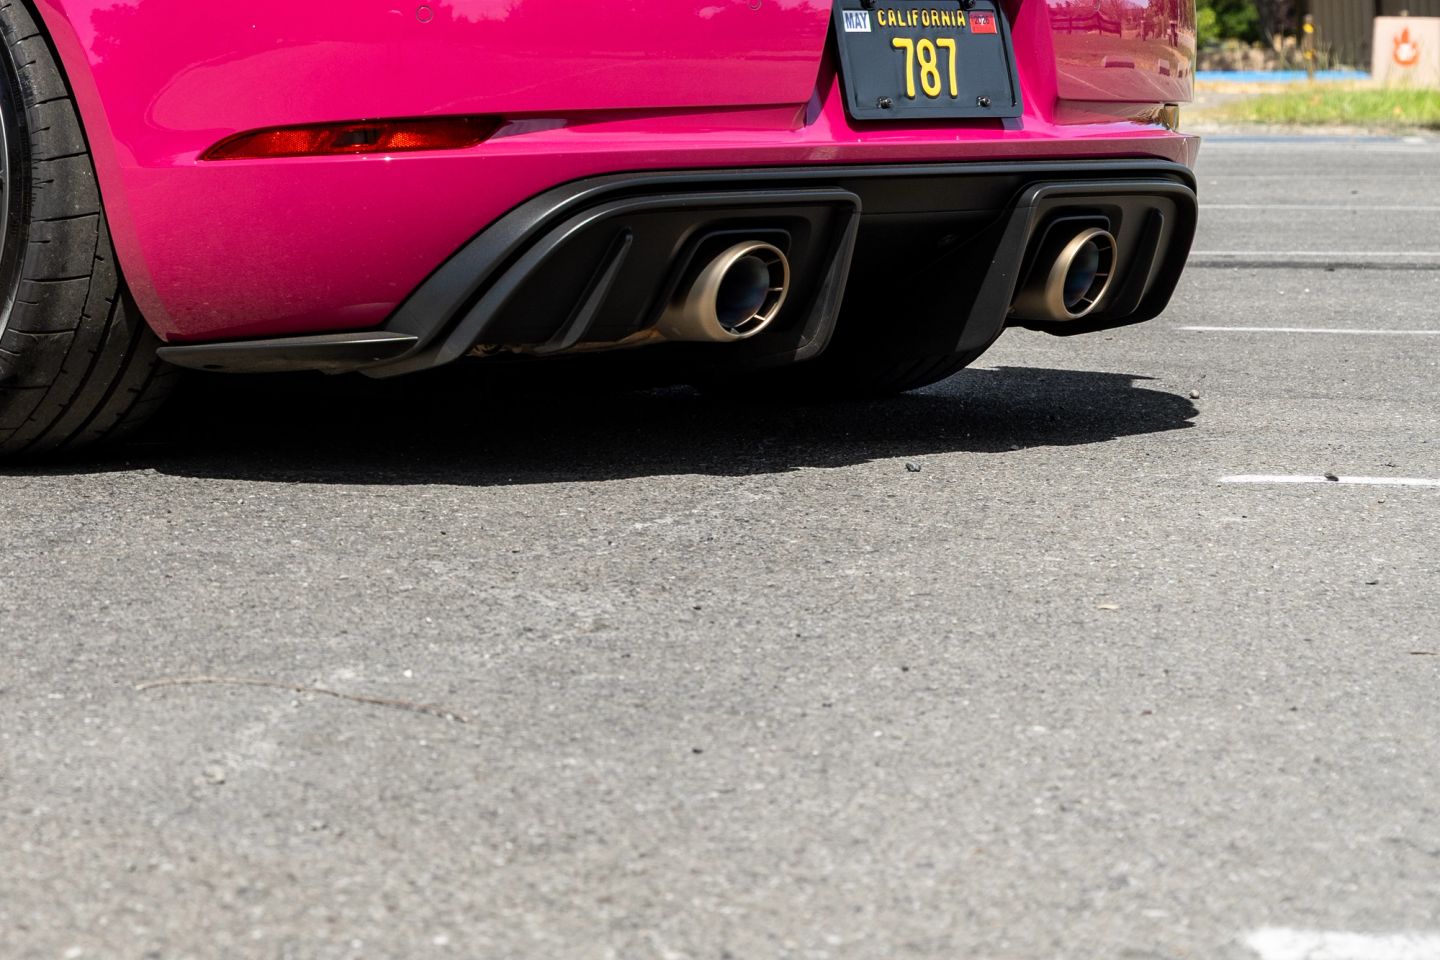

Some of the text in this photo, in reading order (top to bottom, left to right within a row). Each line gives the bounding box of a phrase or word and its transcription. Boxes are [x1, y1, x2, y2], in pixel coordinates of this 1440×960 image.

[844, 11, 868, 29] MAY
[876, 9, 967, 27] CALIFORNIA
[891, 37, 959, 98] 787
